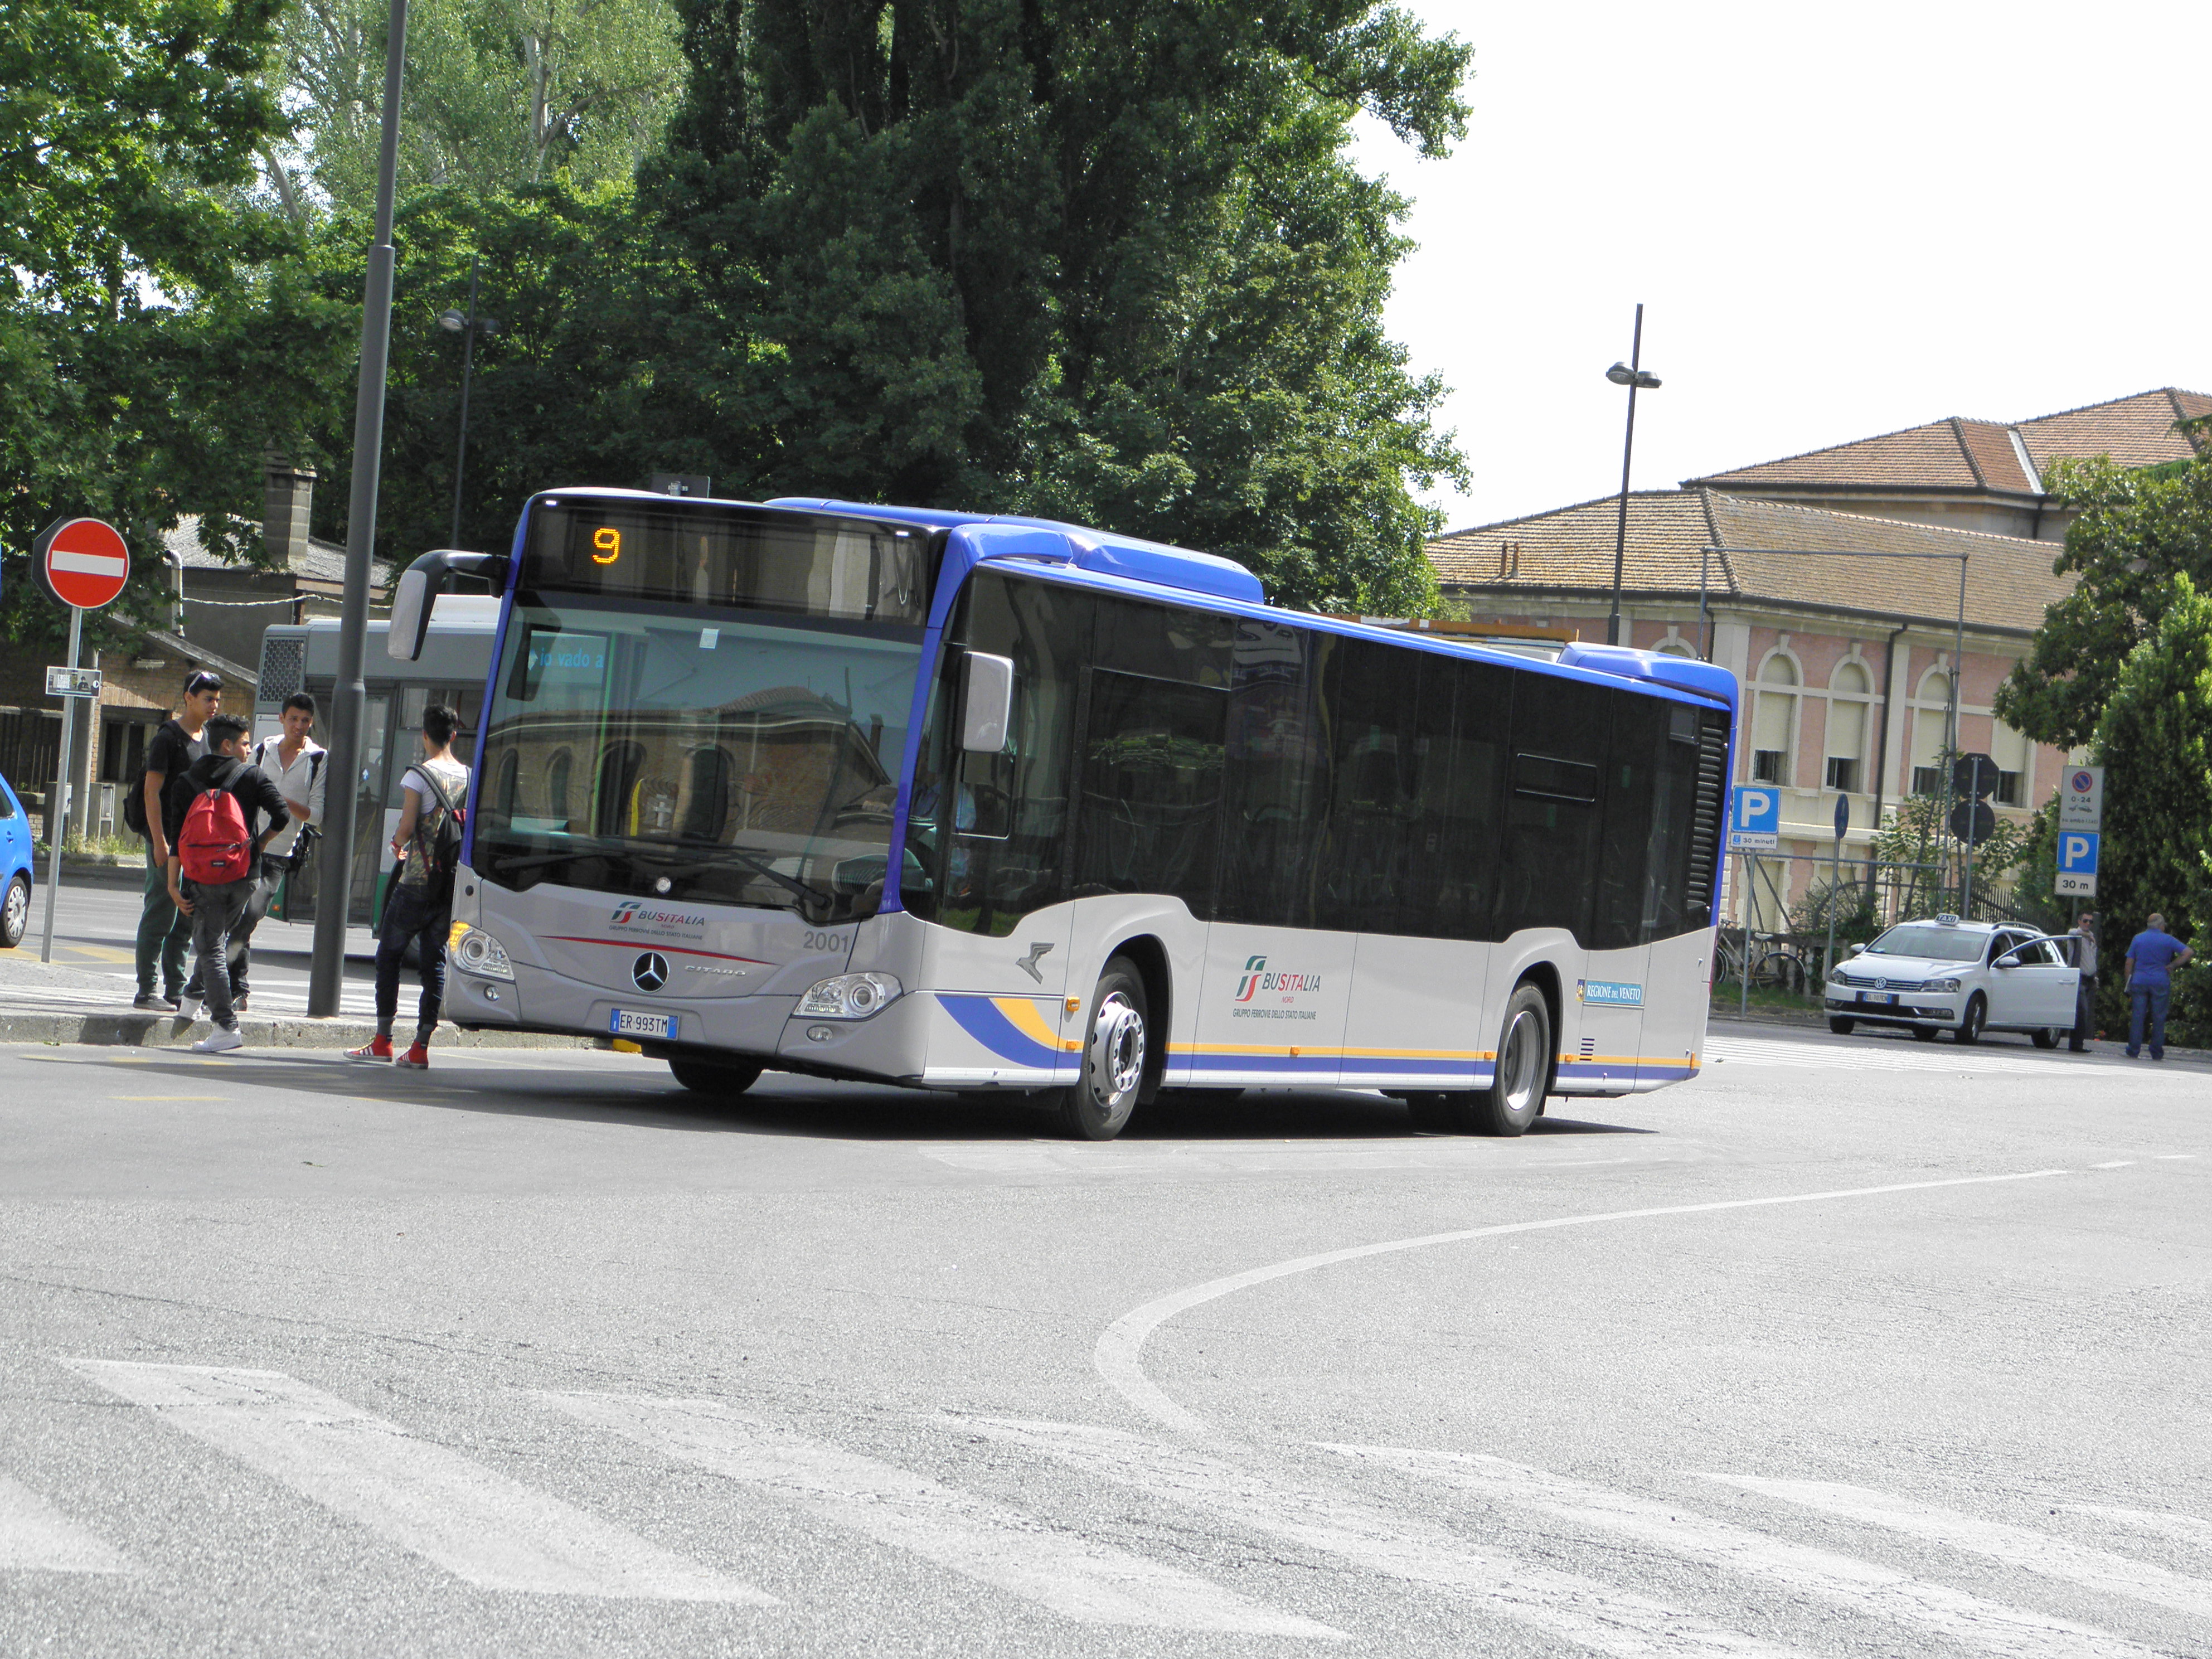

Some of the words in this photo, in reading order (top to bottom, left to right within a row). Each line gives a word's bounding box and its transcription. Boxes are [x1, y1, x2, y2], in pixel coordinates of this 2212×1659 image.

[593, 528, 620, 564] 9
[540, 647, 552, 667] io
[557, 647, 590, 668] vado
[595, 654, 604, 668] a
[1741, 791, 1770, 827] P
[2065, 836, 2089, 868] P
[2063, 880, 2076, 889] 30
[638, 910, 705, 926] BUSITALIA
[803, 930, 849, 953] 2001
[685, 965, 746, 977] CITARO
[1262, 973, 1321, 992] BUSITALIA
[1587, 985, 1611, 998] REGIONE
[1619, 987, 1641, 1000] VENETO
[1233, 1008, 1250, 1017] GRUPPO
[1251, 1009, 1271, 1018] FERROVIE
[1271, 1010, 1285, 1019] DELLO
[1285, 1010, 1299, 1020] STATO
[1298, 1011, 1317, 1020] ITALIANE
